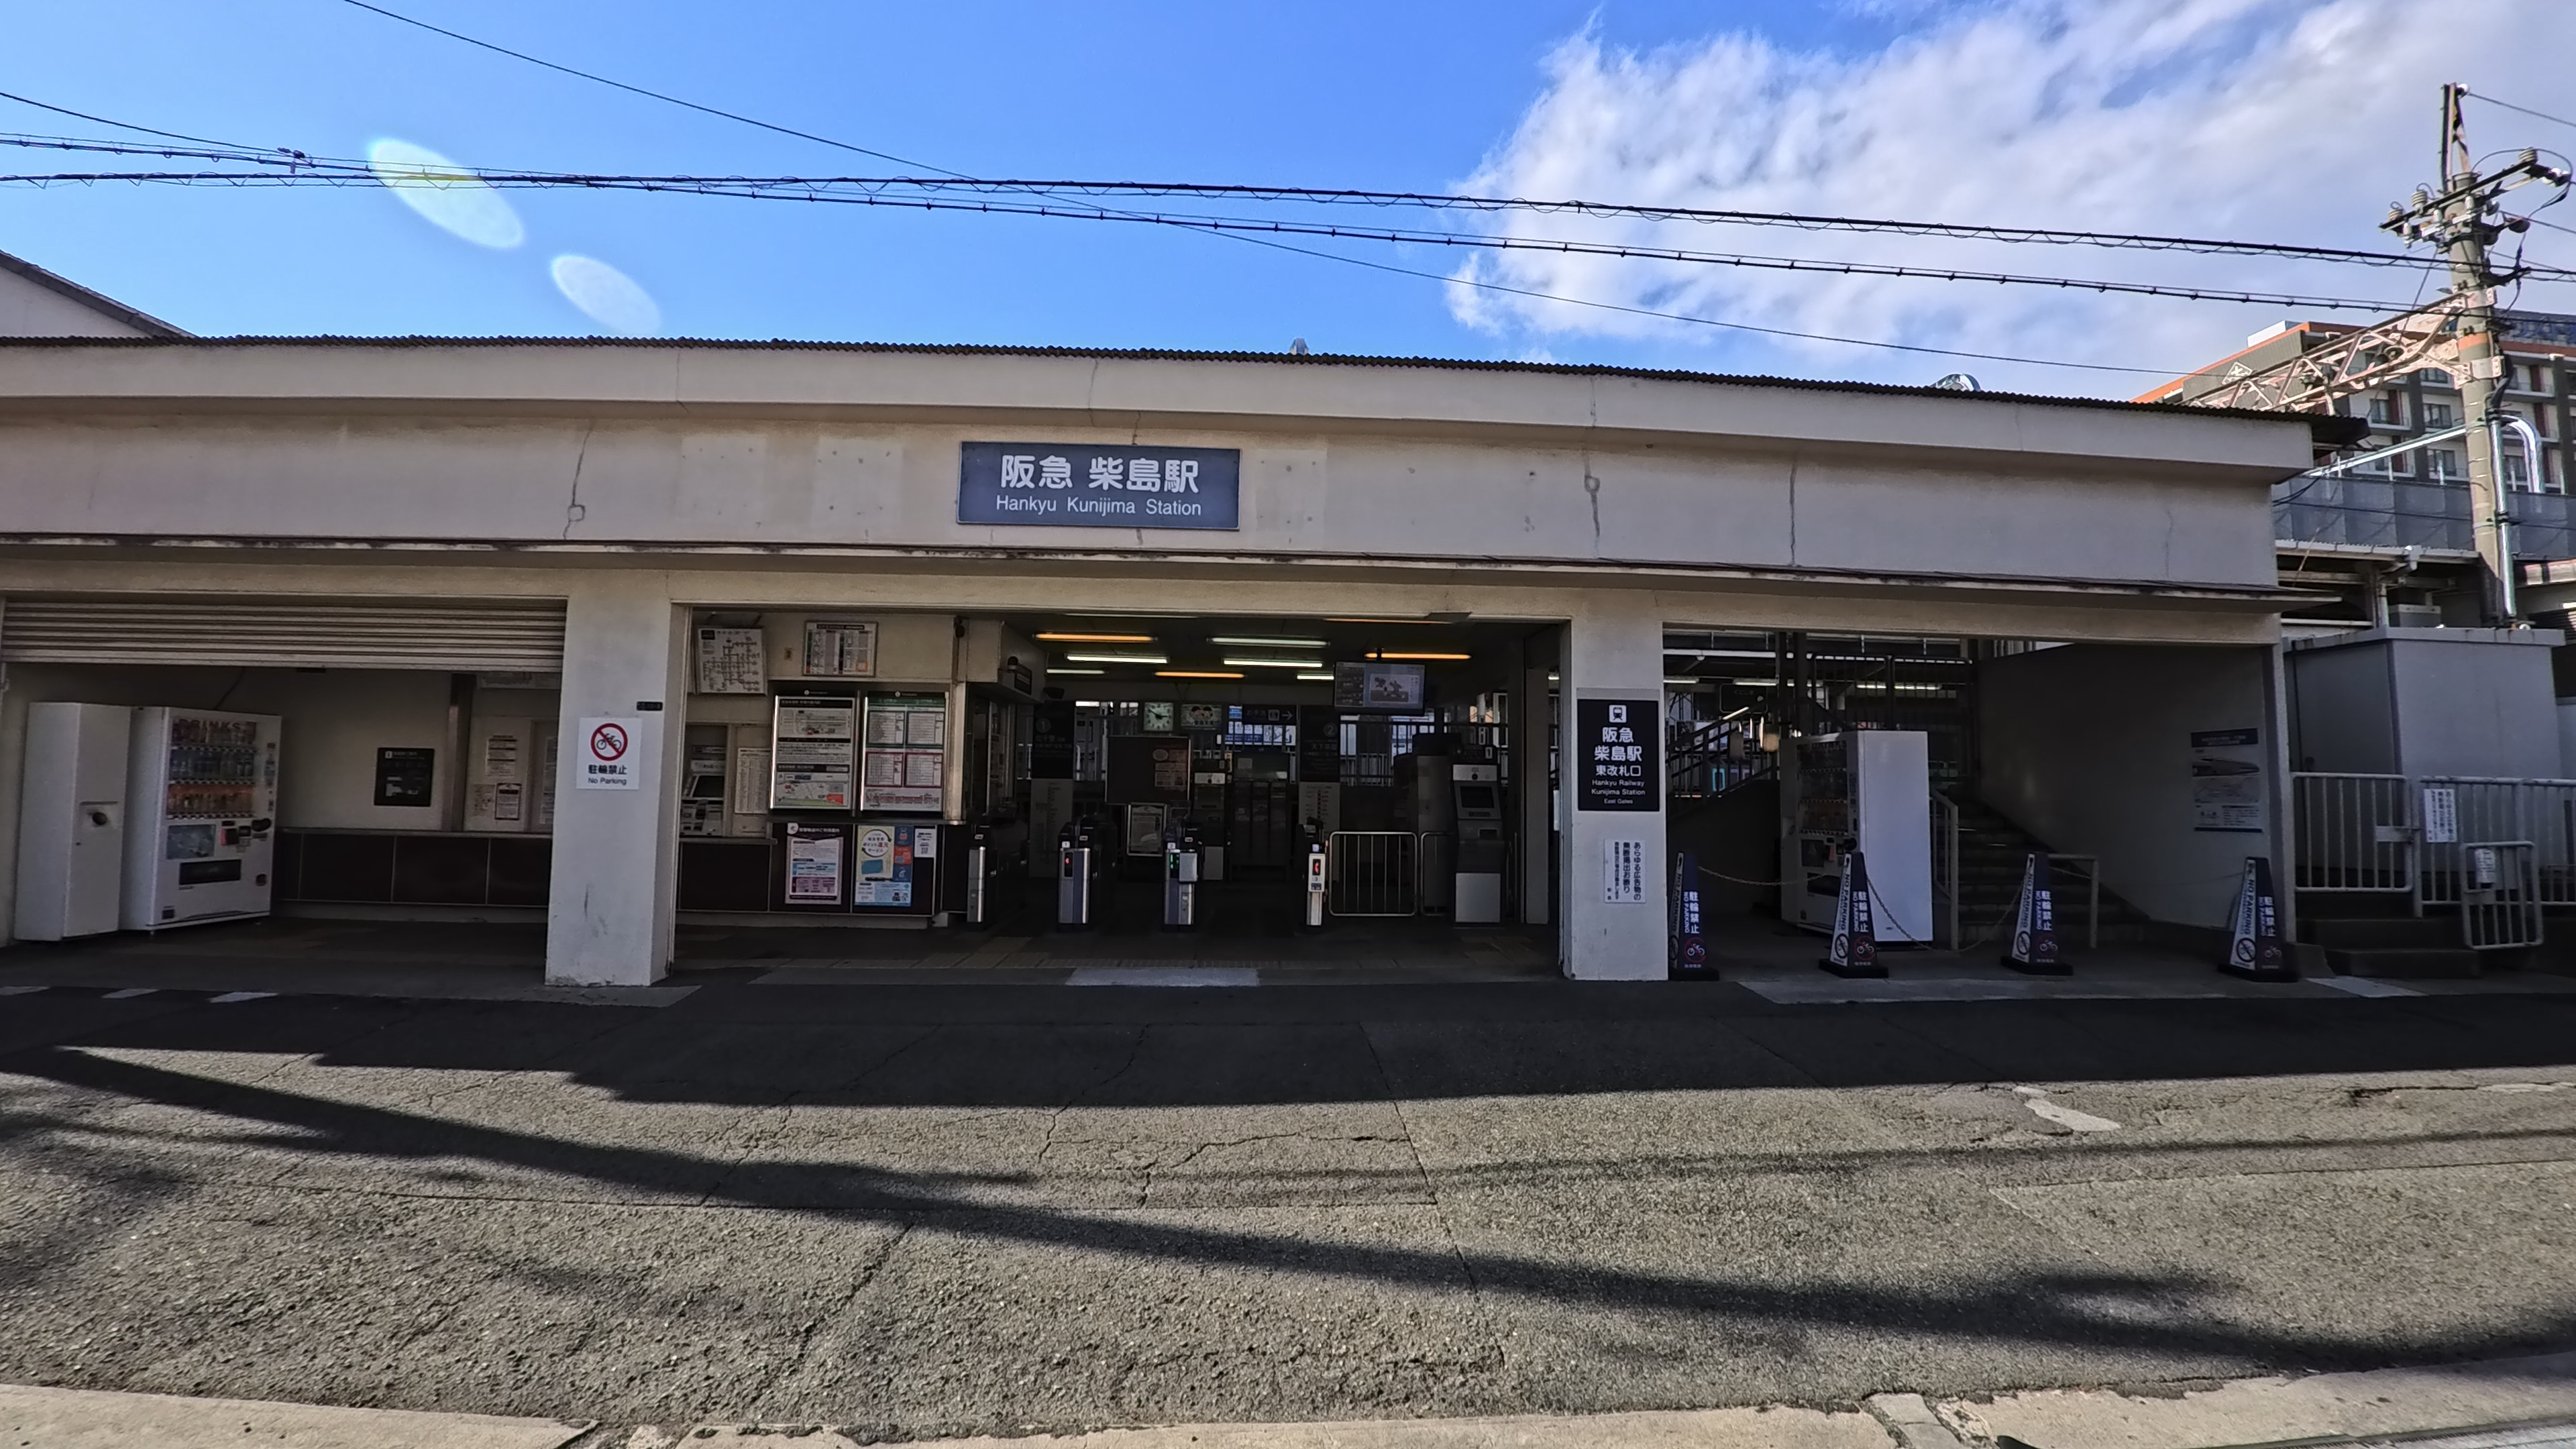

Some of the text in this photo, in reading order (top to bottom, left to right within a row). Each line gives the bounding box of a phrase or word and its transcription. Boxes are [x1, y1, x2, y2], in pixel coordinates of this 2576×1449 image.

[1001, 455, 1199, 494] 阪急 柴島駅
[996, 495, 1201, 517] Hankyu Kunijima Station
[1603, 727, 1633, 743] 阪急
[1594, 745, 1642, 761] 柴島駅
[588, 764, 627, 775] 駐輪禁止
[1595, 765, 1642, 776] 東改札口
[600, 777, 627, 786] Parking
[1683, 892, 1688, 902] NO
[1841, 873, 1849, 930] NO PARKING
[1852, 892, 1858, 901] NO
[2023, 887, 2033, 928] PARKING
[2245, 879, 2255, 935] NO PARKING
[1689, 891, 1700, 934] 駐輪禁止
[1858, 891, 1869, 932] 駐輪禁止
[2042, 890, 2053, 930] 駐輪禁止
